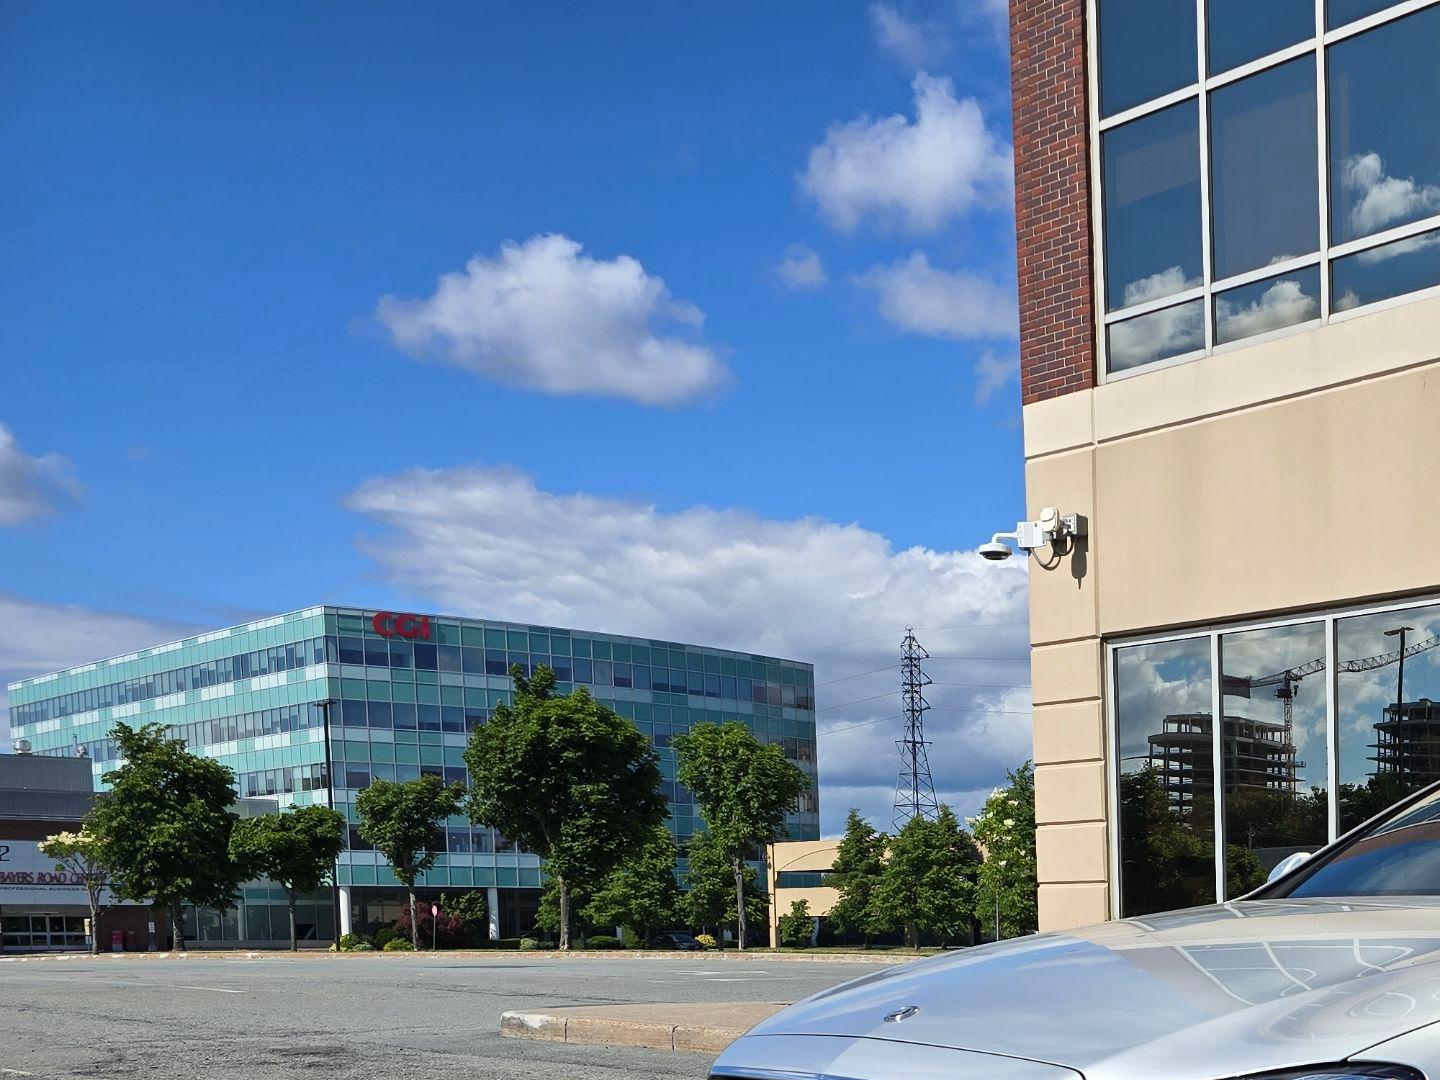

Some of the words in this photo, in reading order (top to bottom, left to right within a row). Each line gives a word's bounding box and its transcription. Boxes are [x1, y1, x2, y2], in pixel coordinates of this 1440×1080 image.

[372, 611, 430, 640] CGI
[0, 871, 34, 883] BAYERS
[37, 872, 67, 884] ROAD
